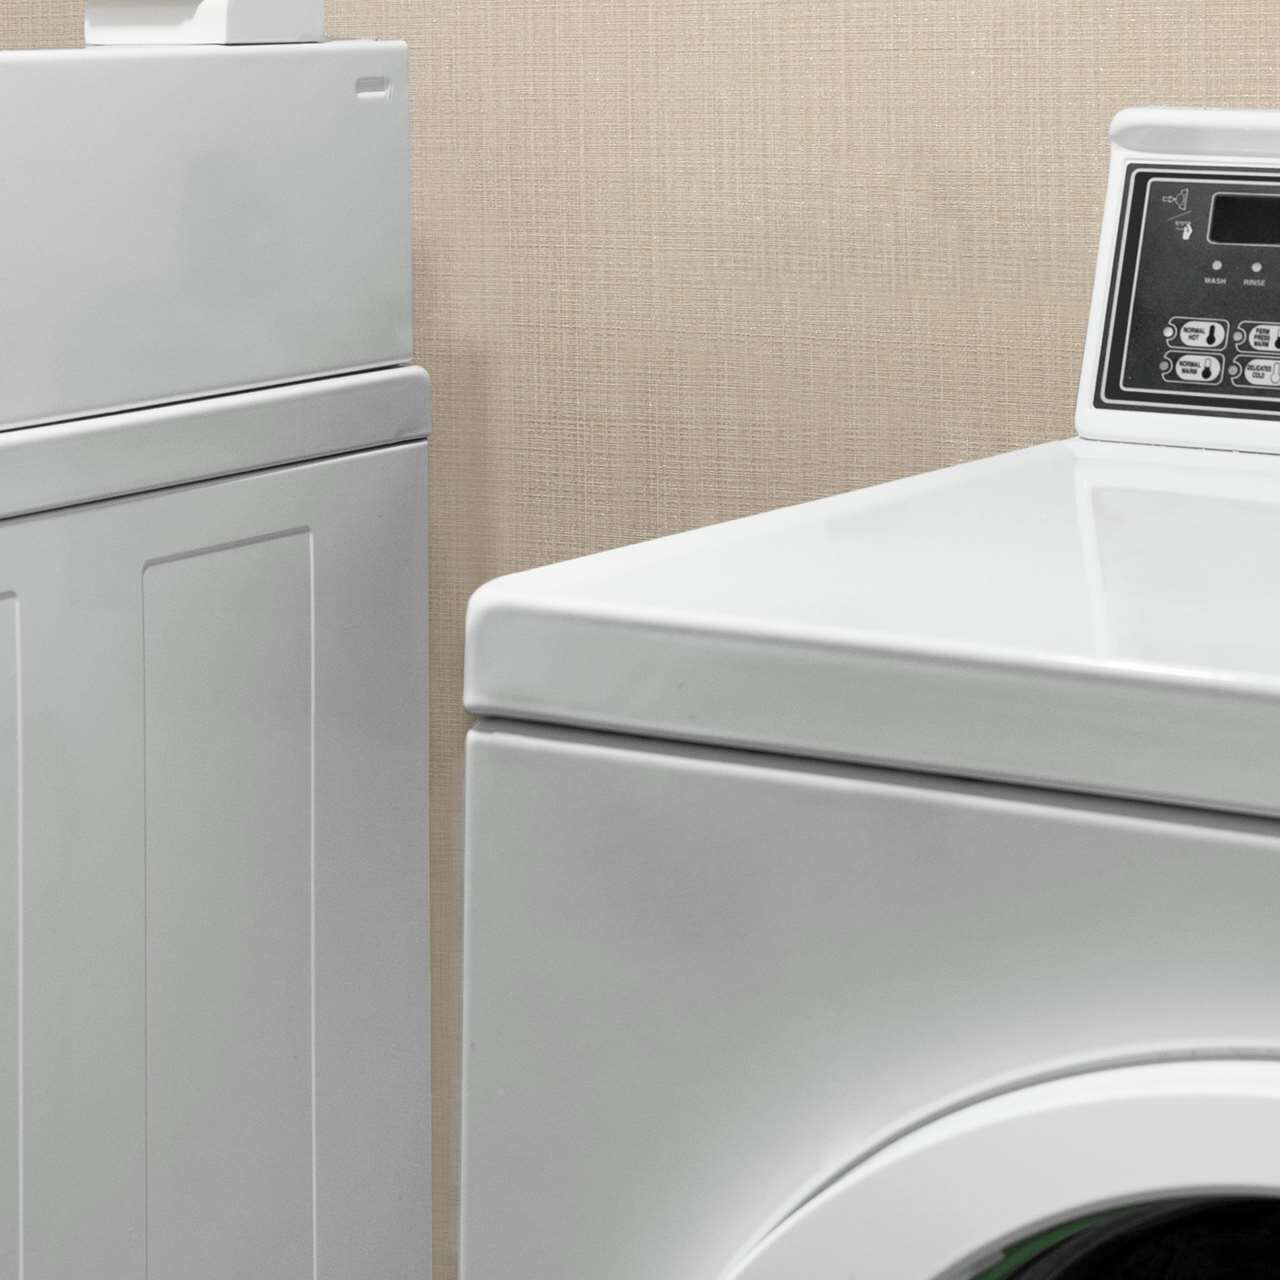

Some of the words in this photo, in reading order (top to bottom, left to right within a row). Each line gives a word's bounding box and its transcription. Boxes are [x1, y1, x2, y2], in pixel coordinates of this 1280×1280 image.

[1203, 277, 1227, 285] WASH
[1242, 278, 1267, 287] RINSE
[1183, 326, 1206, 335] NORMAL
[1179, 360, 1201, 368] NORMAL
[1181, 367, 1198, 375] WARM
